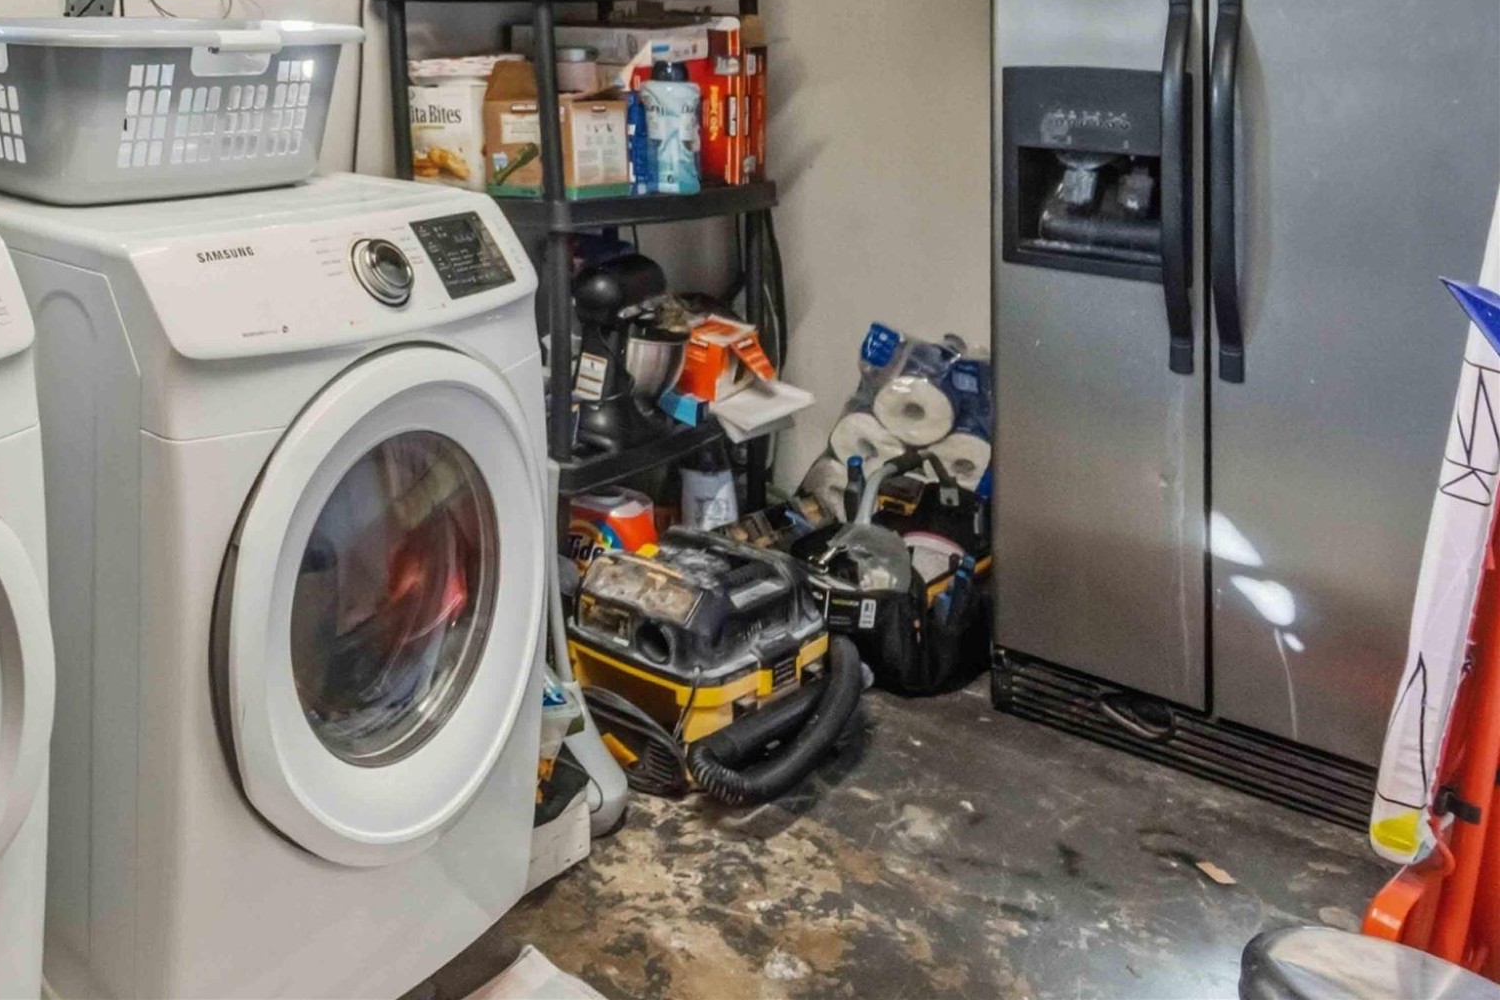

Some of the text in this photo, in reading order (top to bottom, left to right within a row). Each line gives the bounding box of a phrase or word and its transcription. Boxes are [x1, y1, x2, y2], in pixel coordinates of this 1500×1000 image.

[410, 104, 462, 124] ita Bites
[196, 246, 255, 264] SAMSUNG
